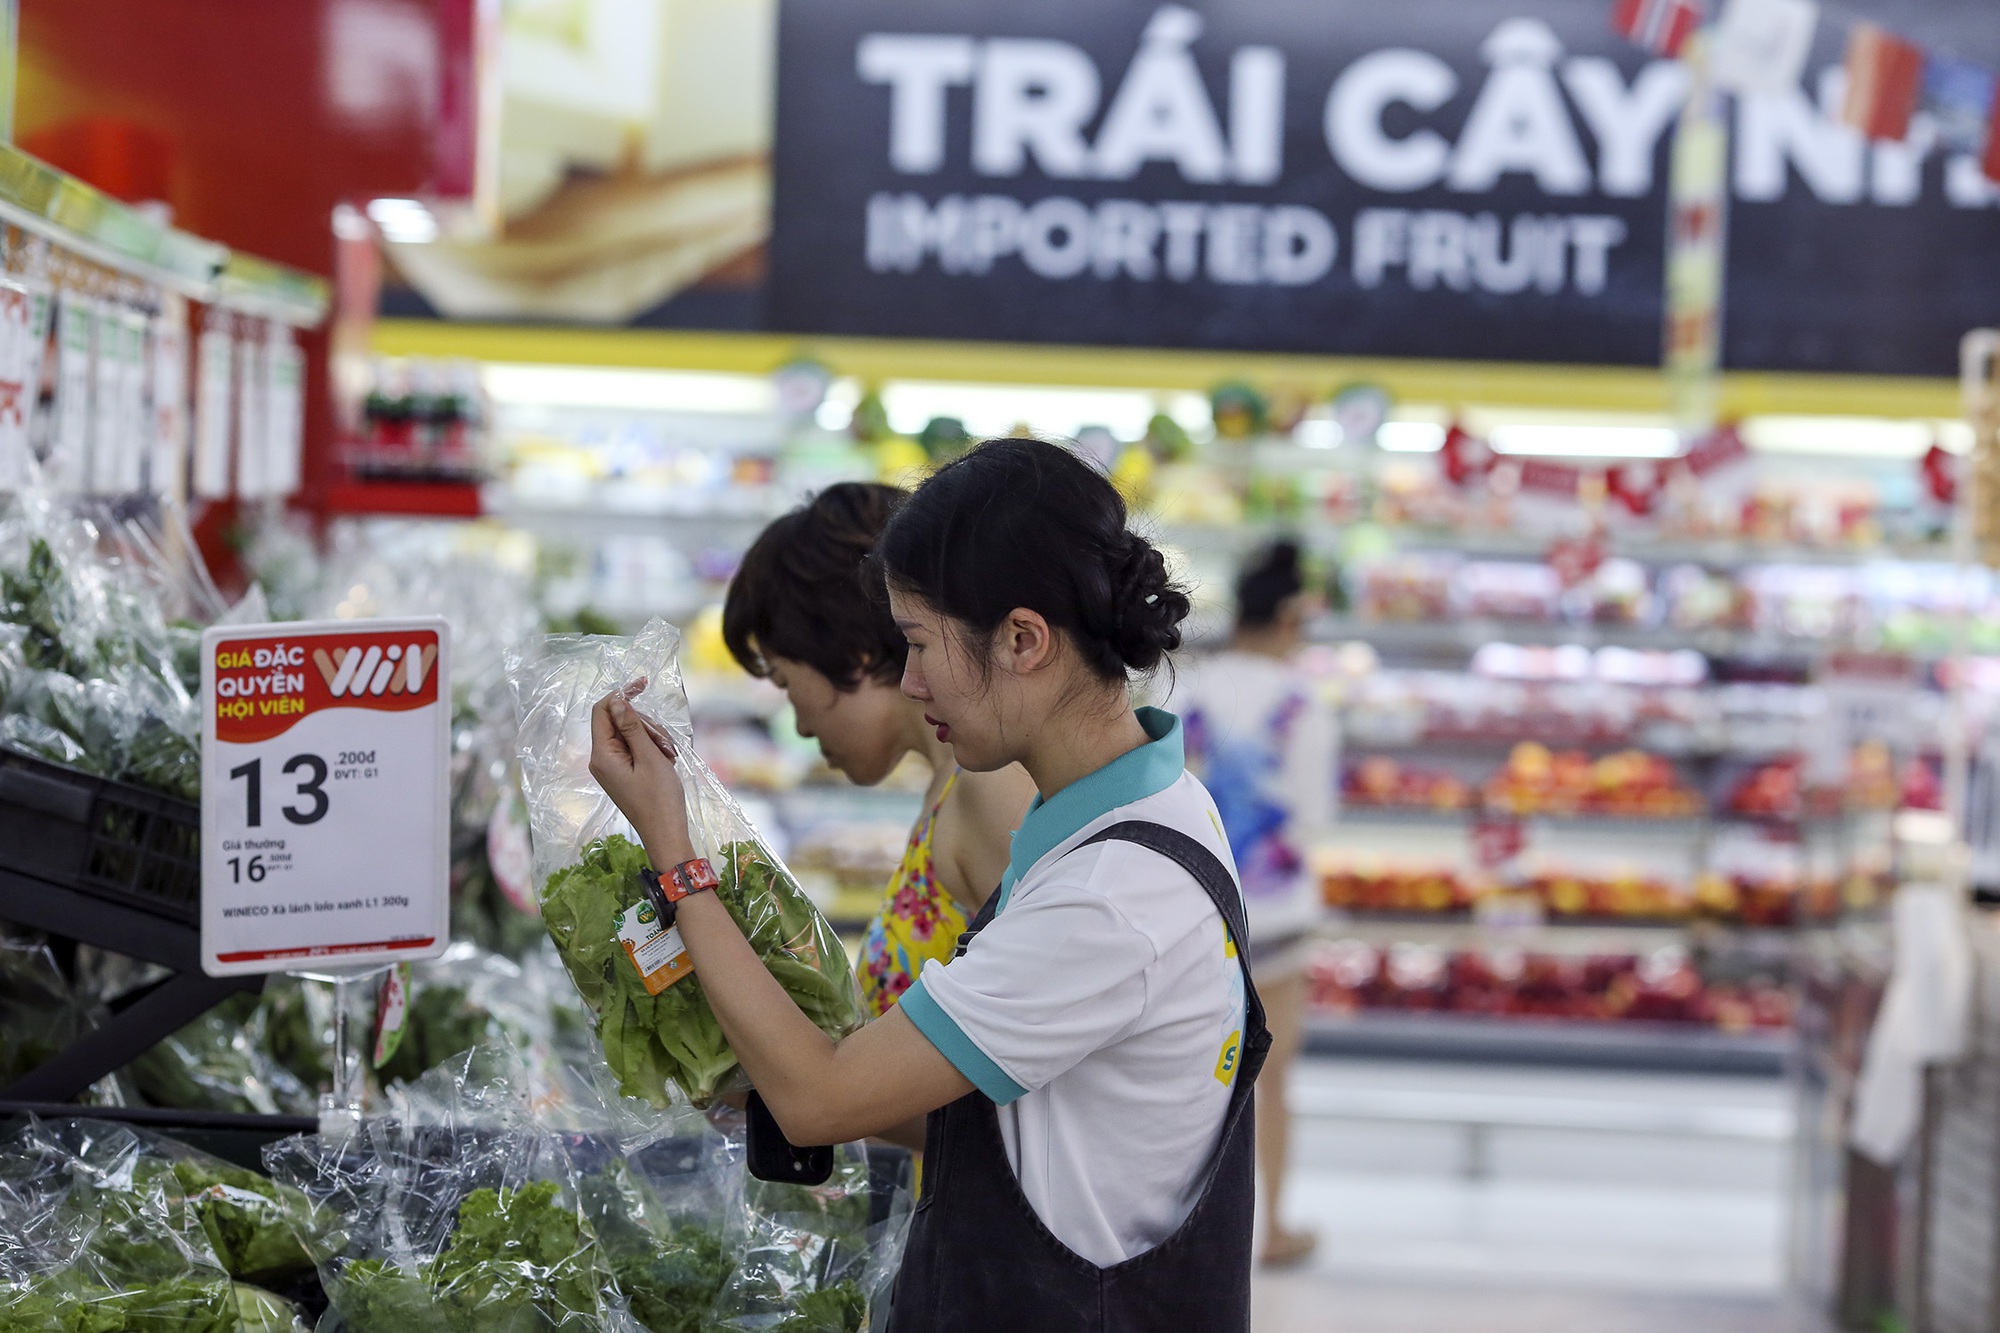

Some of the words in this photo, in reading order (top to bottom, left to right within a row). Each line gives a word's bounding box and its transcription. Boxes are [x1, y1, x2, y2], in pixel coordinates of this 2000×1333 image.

[857, 4, 1286, 186] TRÁI
[1321, 16, 1688, 196] CÂY
[865, 192, 1338, 286] IMPORTED
[1352, 207, 1627, 296] FRUIT
[217, 647, 252, 669] GIÁ
[218, 697, 254, 721] HỘI
[259, 695, 305, 716] VIÊN
[230, 753, 329, 828] 13
[227, 854, 266, 884] 16
